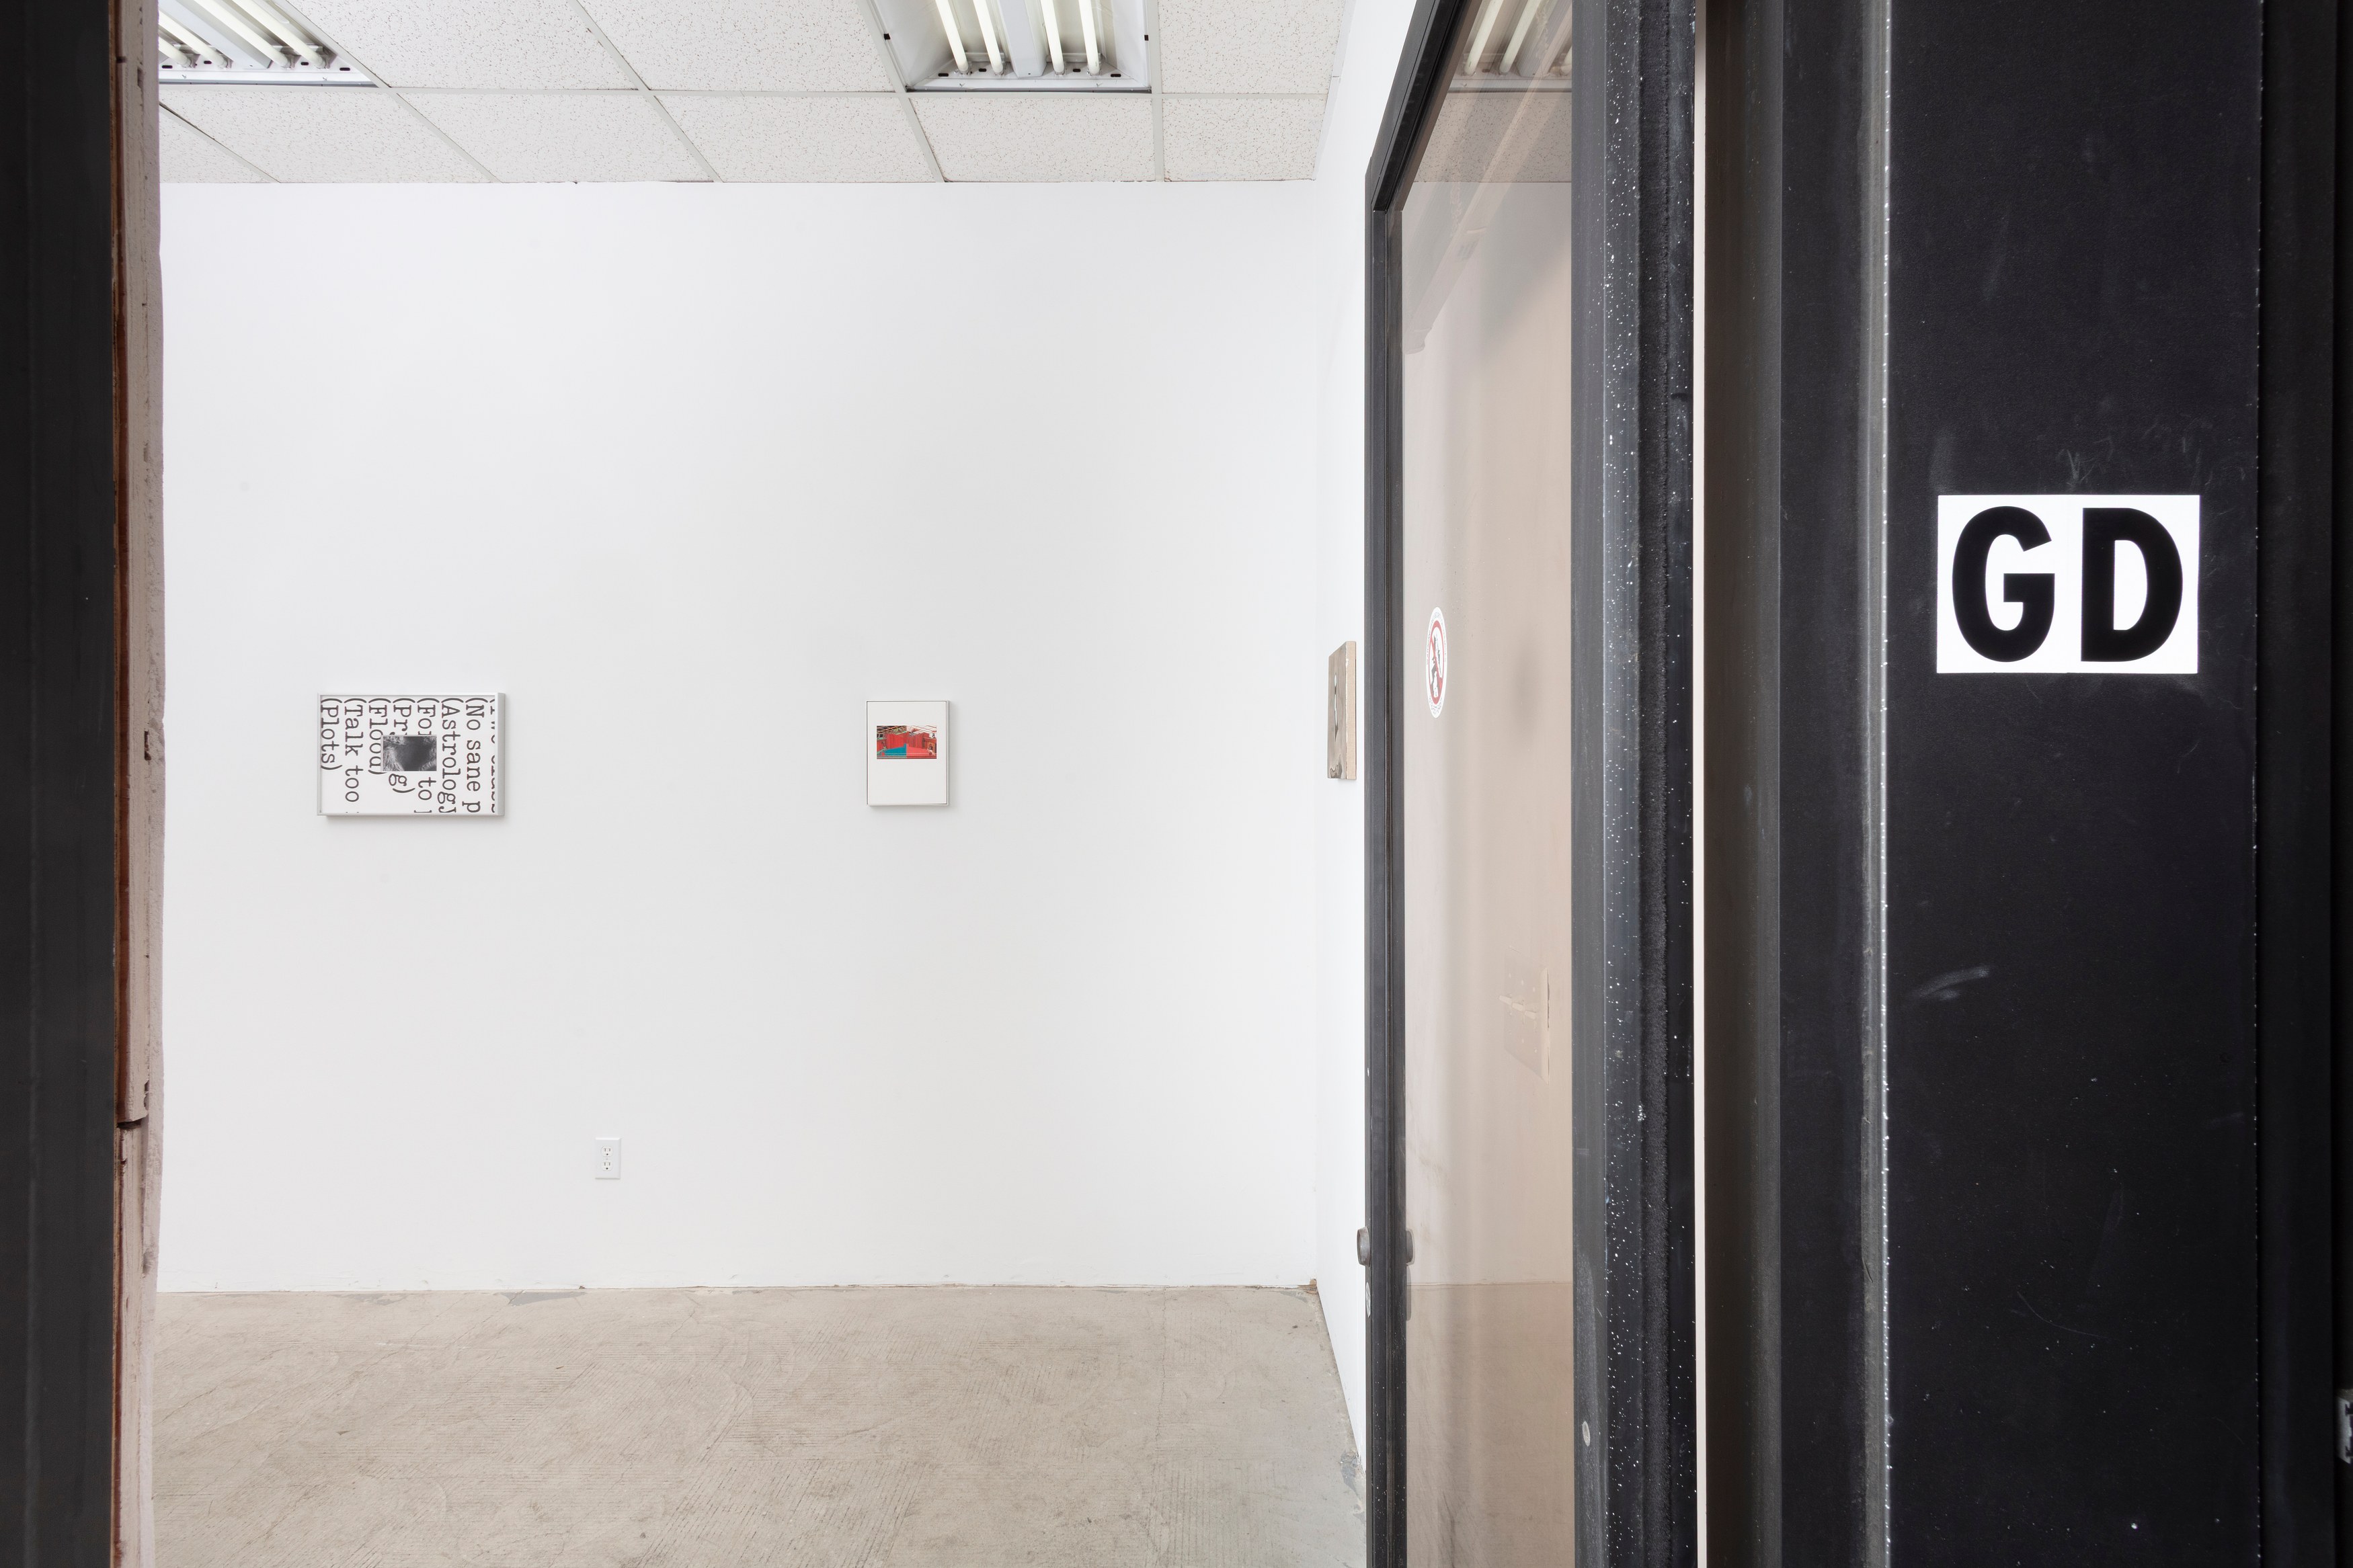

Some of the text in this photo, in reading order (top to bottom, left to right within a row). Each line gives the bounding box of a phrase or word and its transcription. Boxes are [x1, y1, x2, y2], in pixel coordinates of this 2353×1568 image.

[1952, 505, 2184, 663] GD
[321, 698, 343, 770] (Plots)
[344, 698, 367, 756] (Talk
[465, 698, 488, 731] (No
[345, 766, 364, 802] too
[418, 777, 436, 800] to
[466, 740, 481, 792] sane
